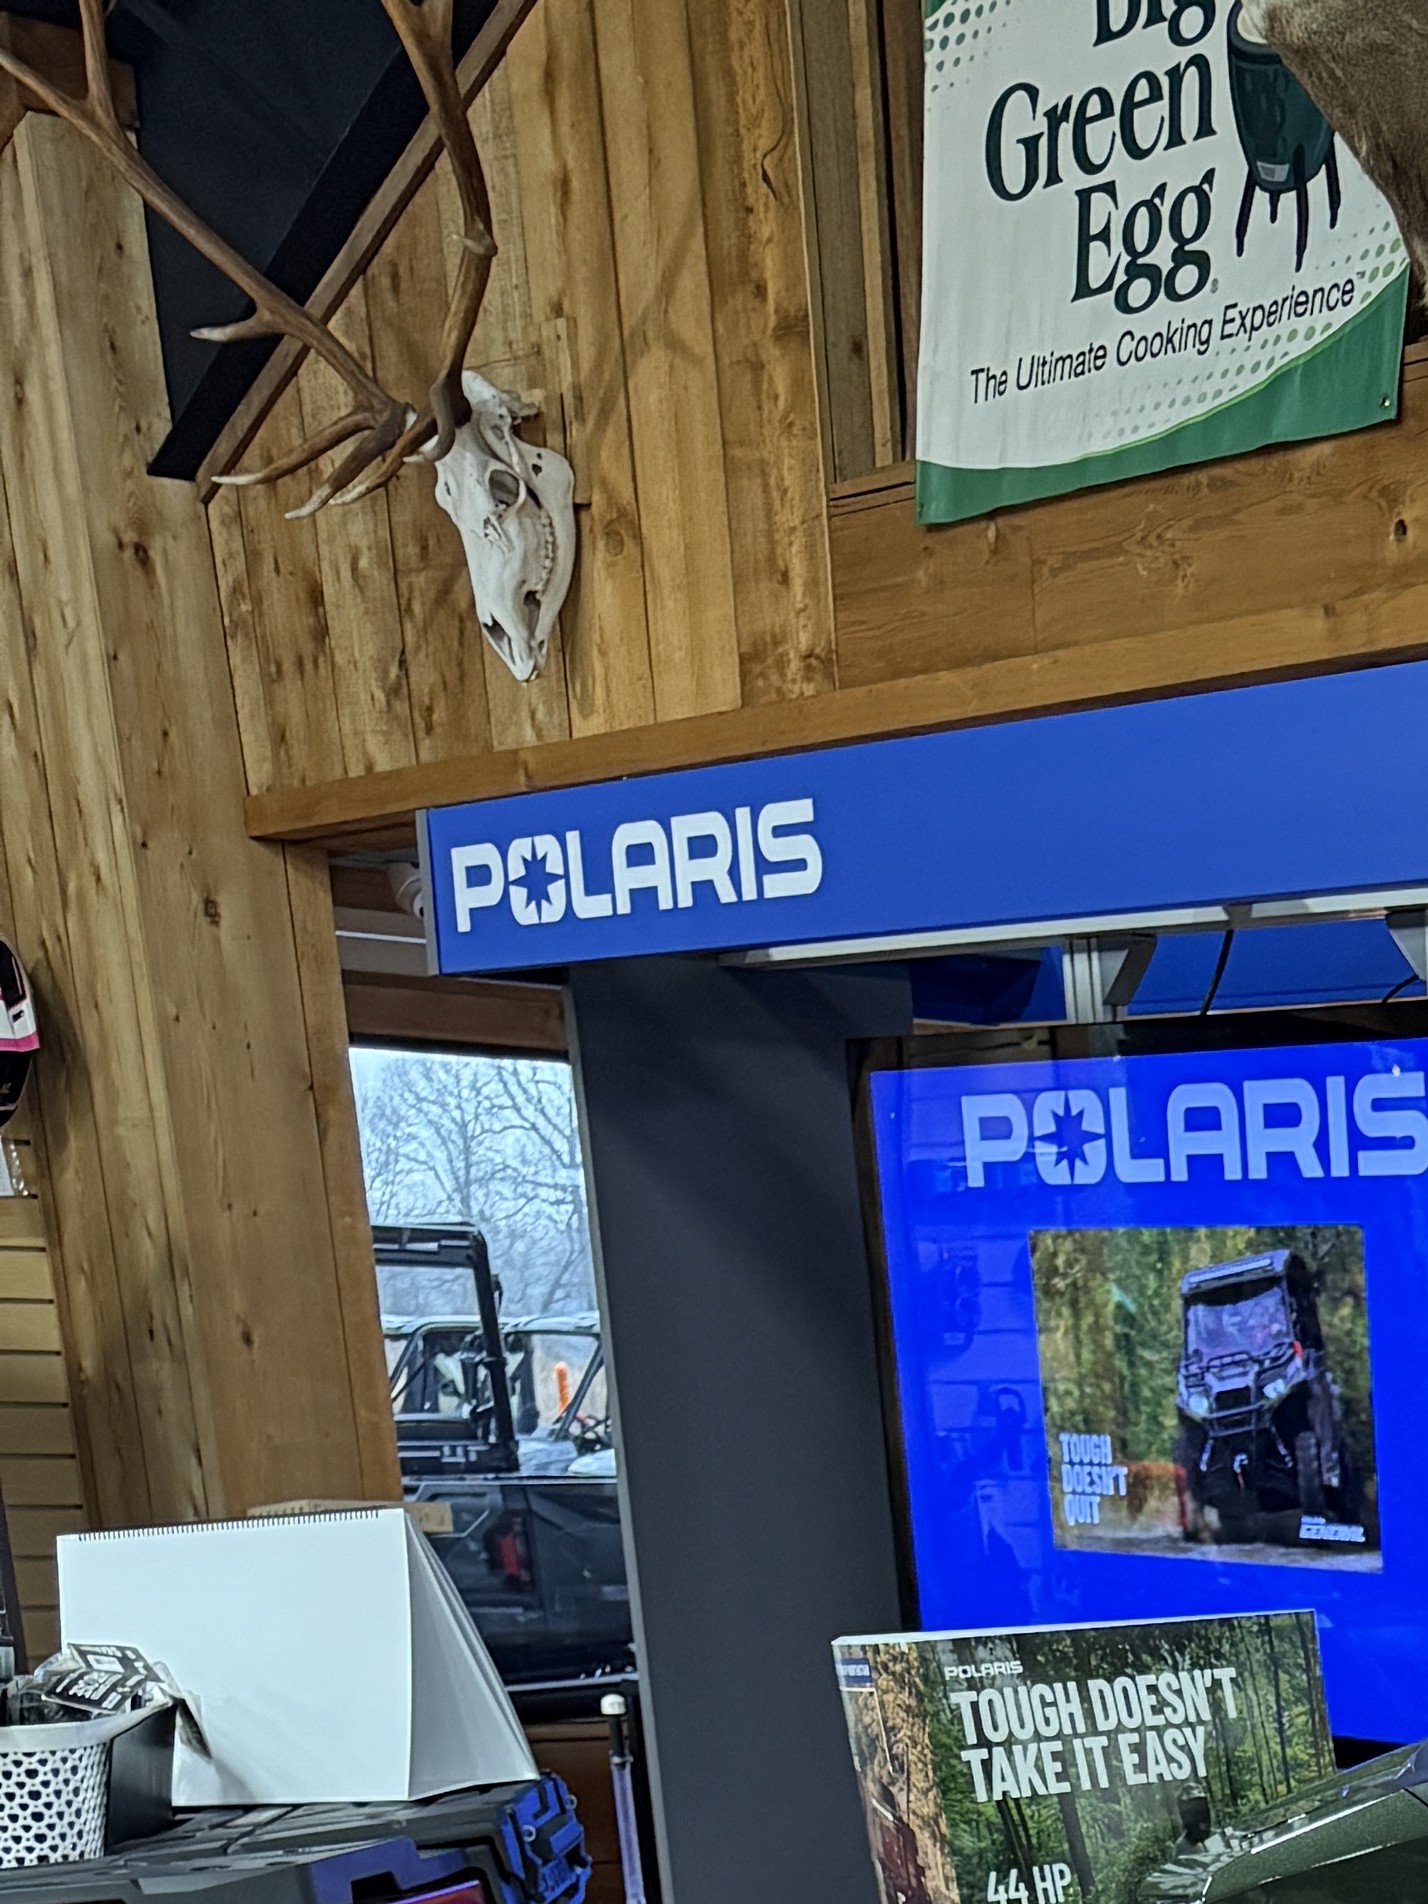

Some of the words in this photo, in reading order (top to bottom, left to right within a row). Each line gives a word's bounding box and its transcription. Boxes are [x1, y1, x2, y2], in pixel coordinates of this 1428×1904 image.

[985, 53, 1218, 203] Green
[970, 367, 1008, 405] The
[1014, 341, 1108, 392] Ultimate
[1113, 314, 1213, 370] Cooking
[450, 797, 824, 934] POLARIS
[1059, 1432, 1113, 1465] TOUGH
[1060, 1464, 1129, 1496] DOESN'T
[944, 1660, 1023, 1680] POLARIS
[949, 1681, 1086, 1745] TOUGH
[1087, 1667, 1237, 1732] DOESN'T
[960, 1740, 1071, 1803] TAKE
[1072, 1735, 1110, 1791] IT
[1117, 1725, 1208, 1786] EASY
